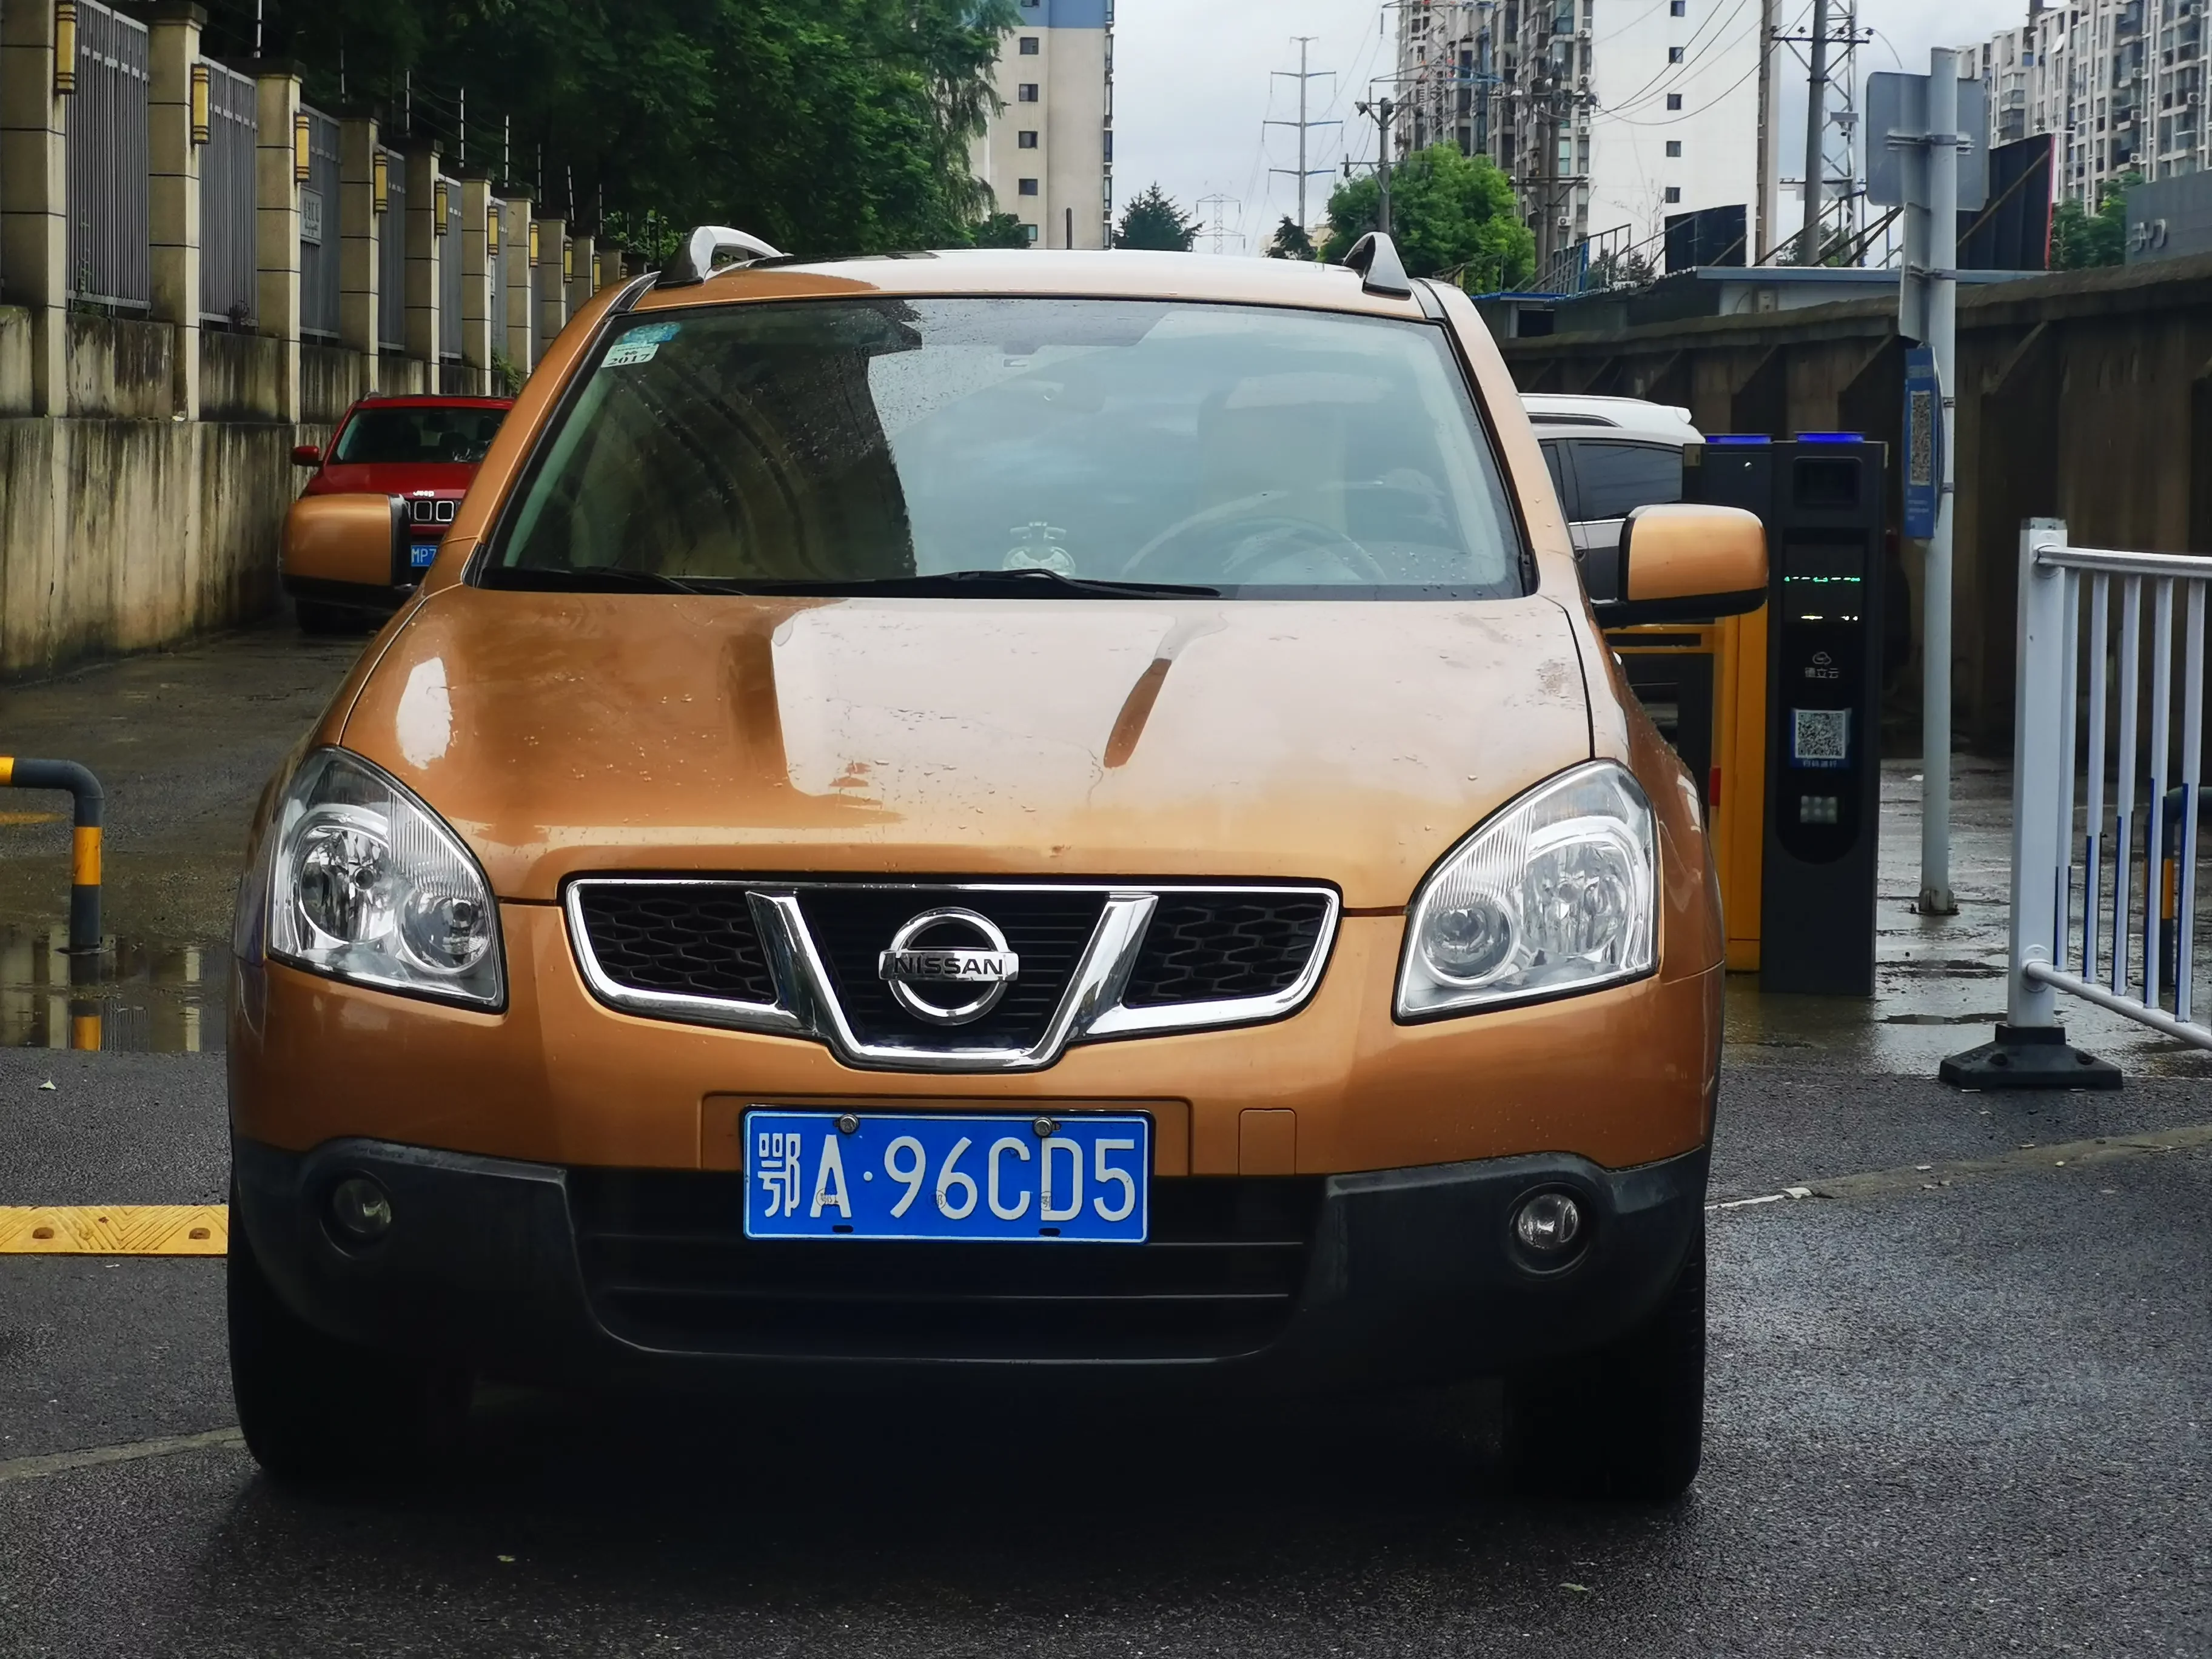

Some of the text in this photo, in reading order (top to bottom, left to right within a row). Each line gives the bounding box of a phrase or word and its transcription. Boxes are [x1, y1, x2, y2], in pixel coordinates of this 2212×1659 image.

[608, 354, 650, 365] 2017
[894, 957, 1003, 974] NISSAN
[758, 1133, 1136, 1221] 鄂A·96CD5
